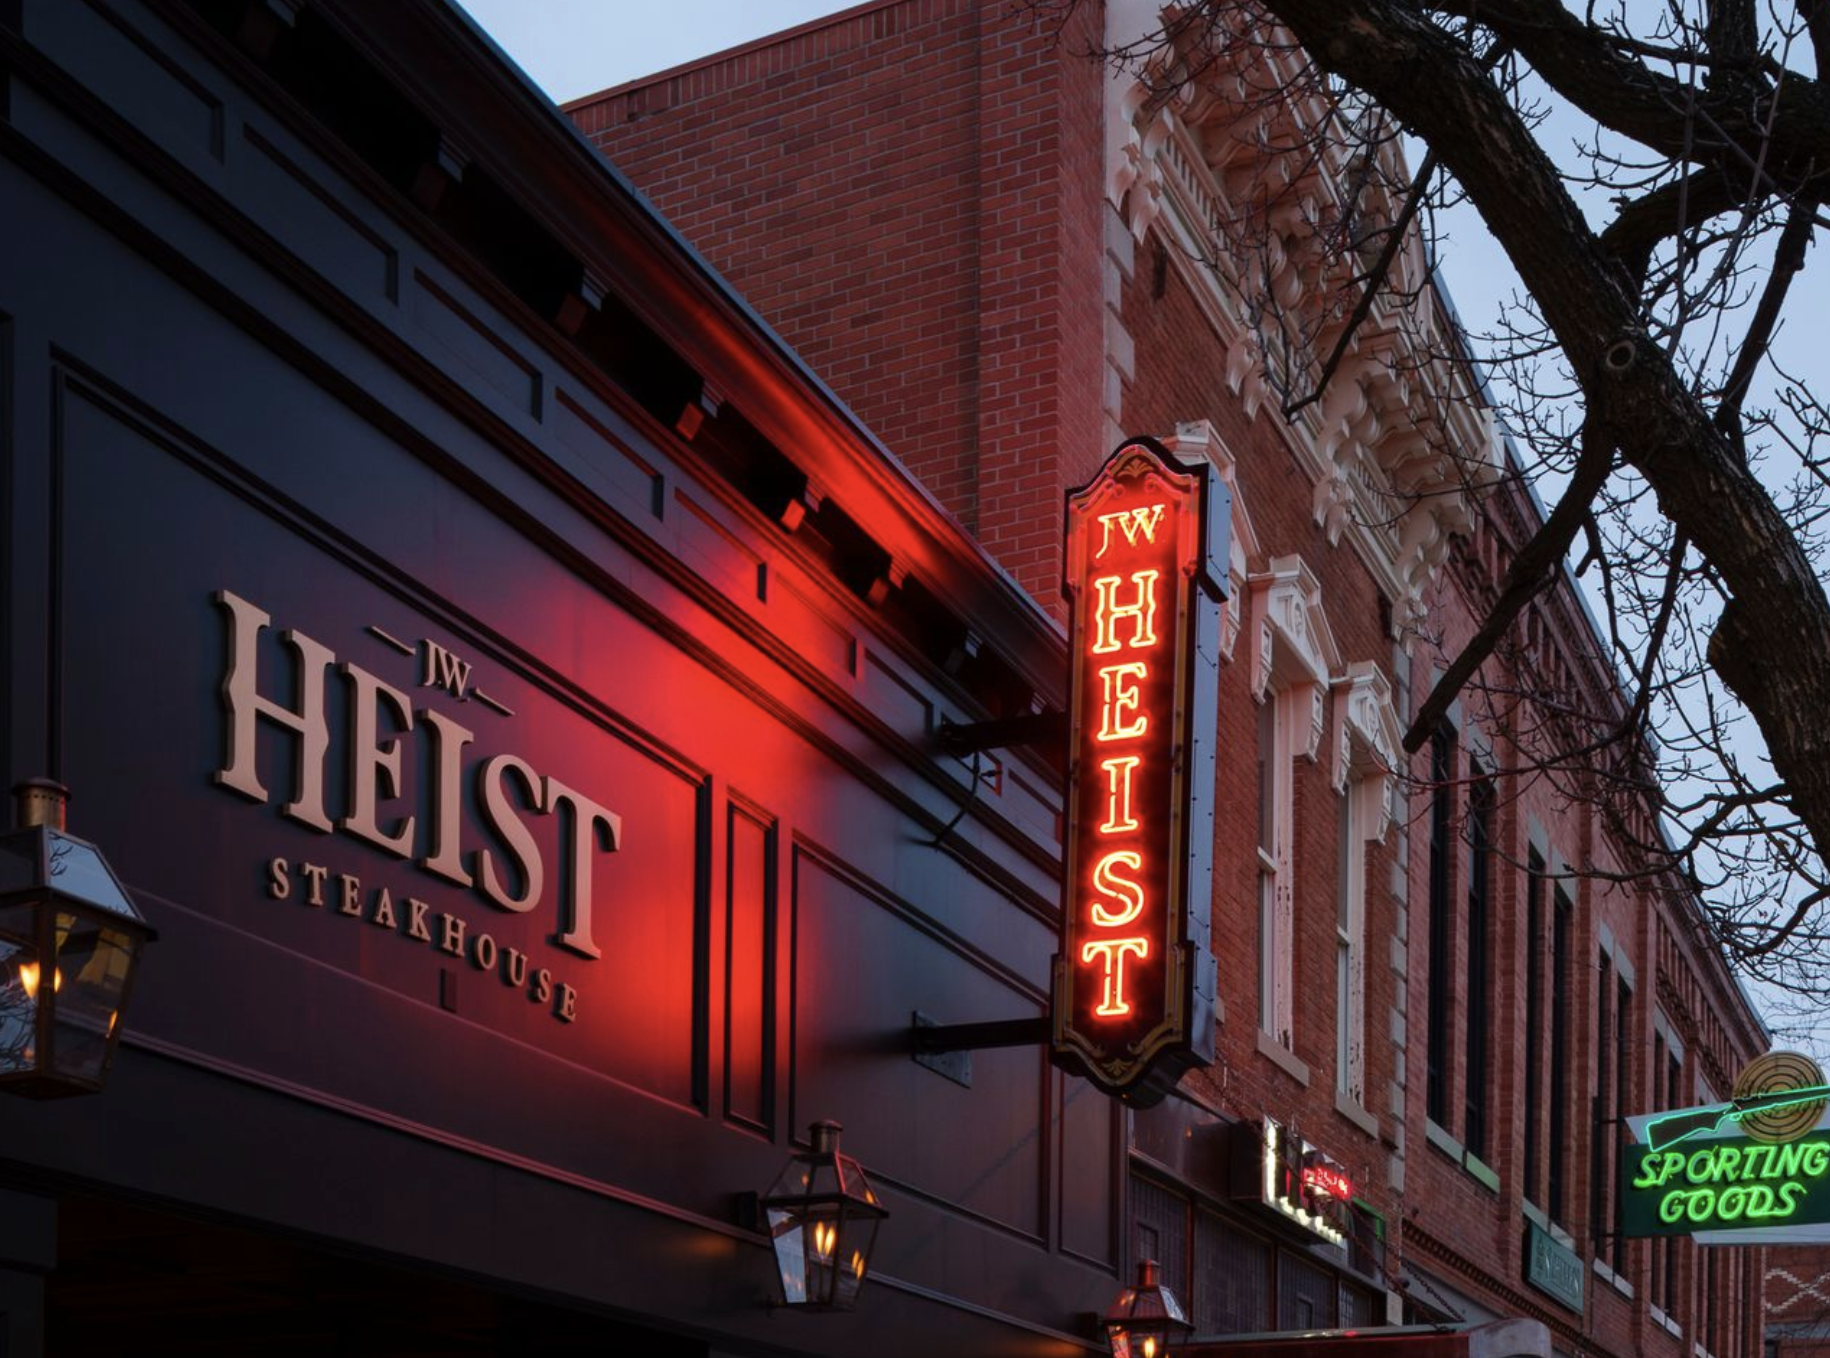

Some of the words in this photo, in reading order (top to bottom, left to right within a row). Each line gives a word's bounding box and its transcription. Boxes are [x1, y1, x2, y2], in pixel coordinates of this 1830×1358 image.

[214, 589, 622, 960] HEIST
[1082, 570, 1159, 1016] HEIST
[269, 857, 577, 1022] STEAKHOUSE
[1633, 1141, 1830, 1187] SPORTING
[1659, 1182, 1807, 1223] GOODS
